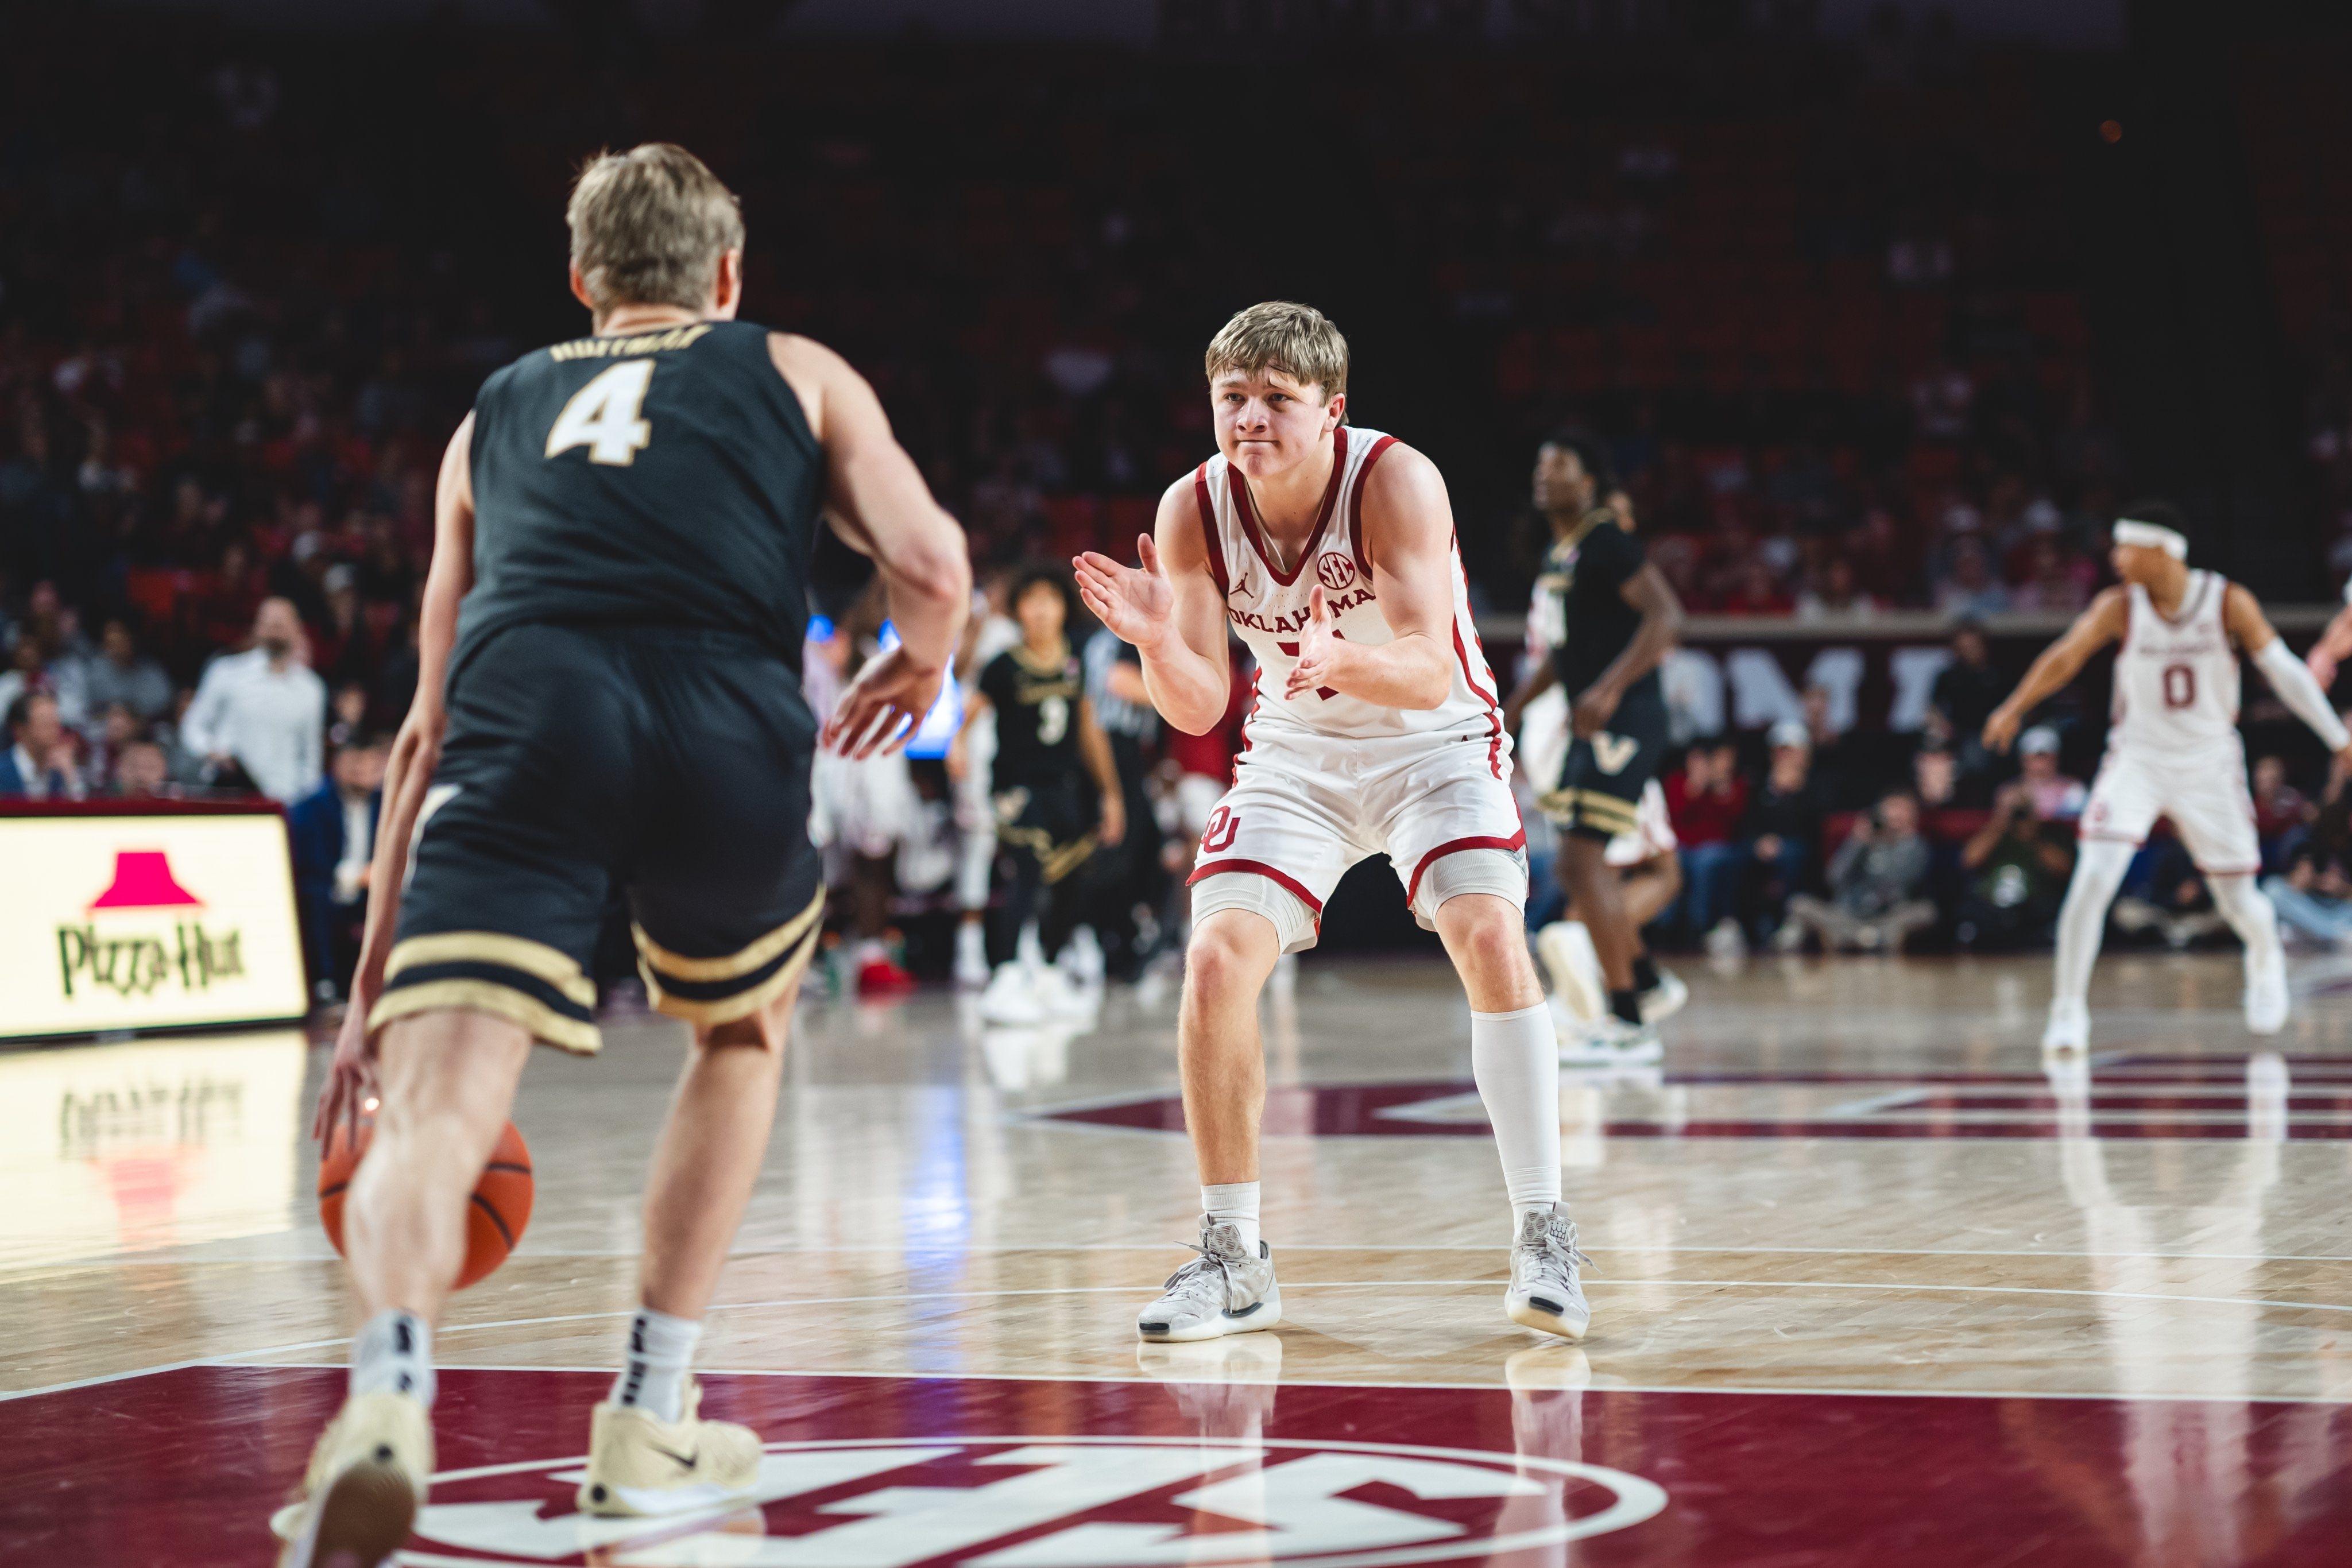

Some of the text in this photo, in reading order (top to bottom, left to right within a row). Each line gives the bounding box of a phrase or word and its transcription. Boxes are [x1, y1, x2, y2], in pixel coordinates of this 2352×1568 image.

[544, 358, 656, 467] 4
[1318, 554, 1354, 589] SEC
[1227, 589, 1376, 633] OKLAHMA
[2163, 663, 2198, 710] 0
[57, 919, 245, 997] Pizza Hut
